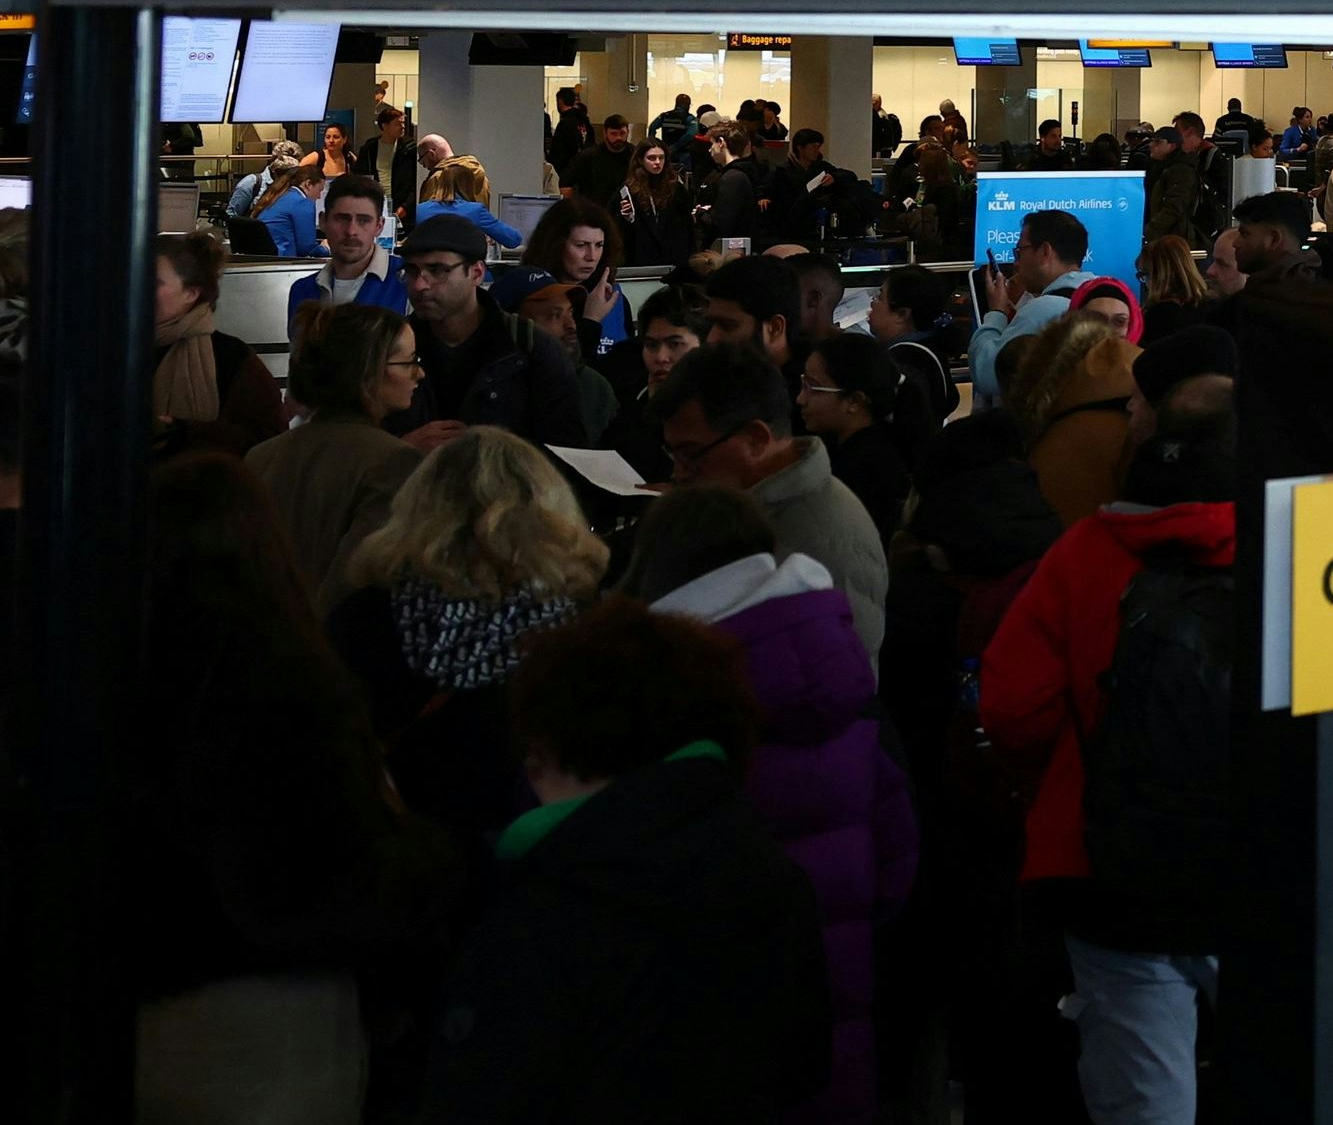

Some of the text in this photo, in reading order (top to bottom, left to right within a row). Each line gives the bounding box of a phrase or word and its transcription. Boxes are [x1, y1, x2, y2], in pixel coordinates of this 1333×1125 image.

[988, 199, 1112, 211] KLM Royal Dutch Airlines
[987, 230, 1020, 244] Pleas
